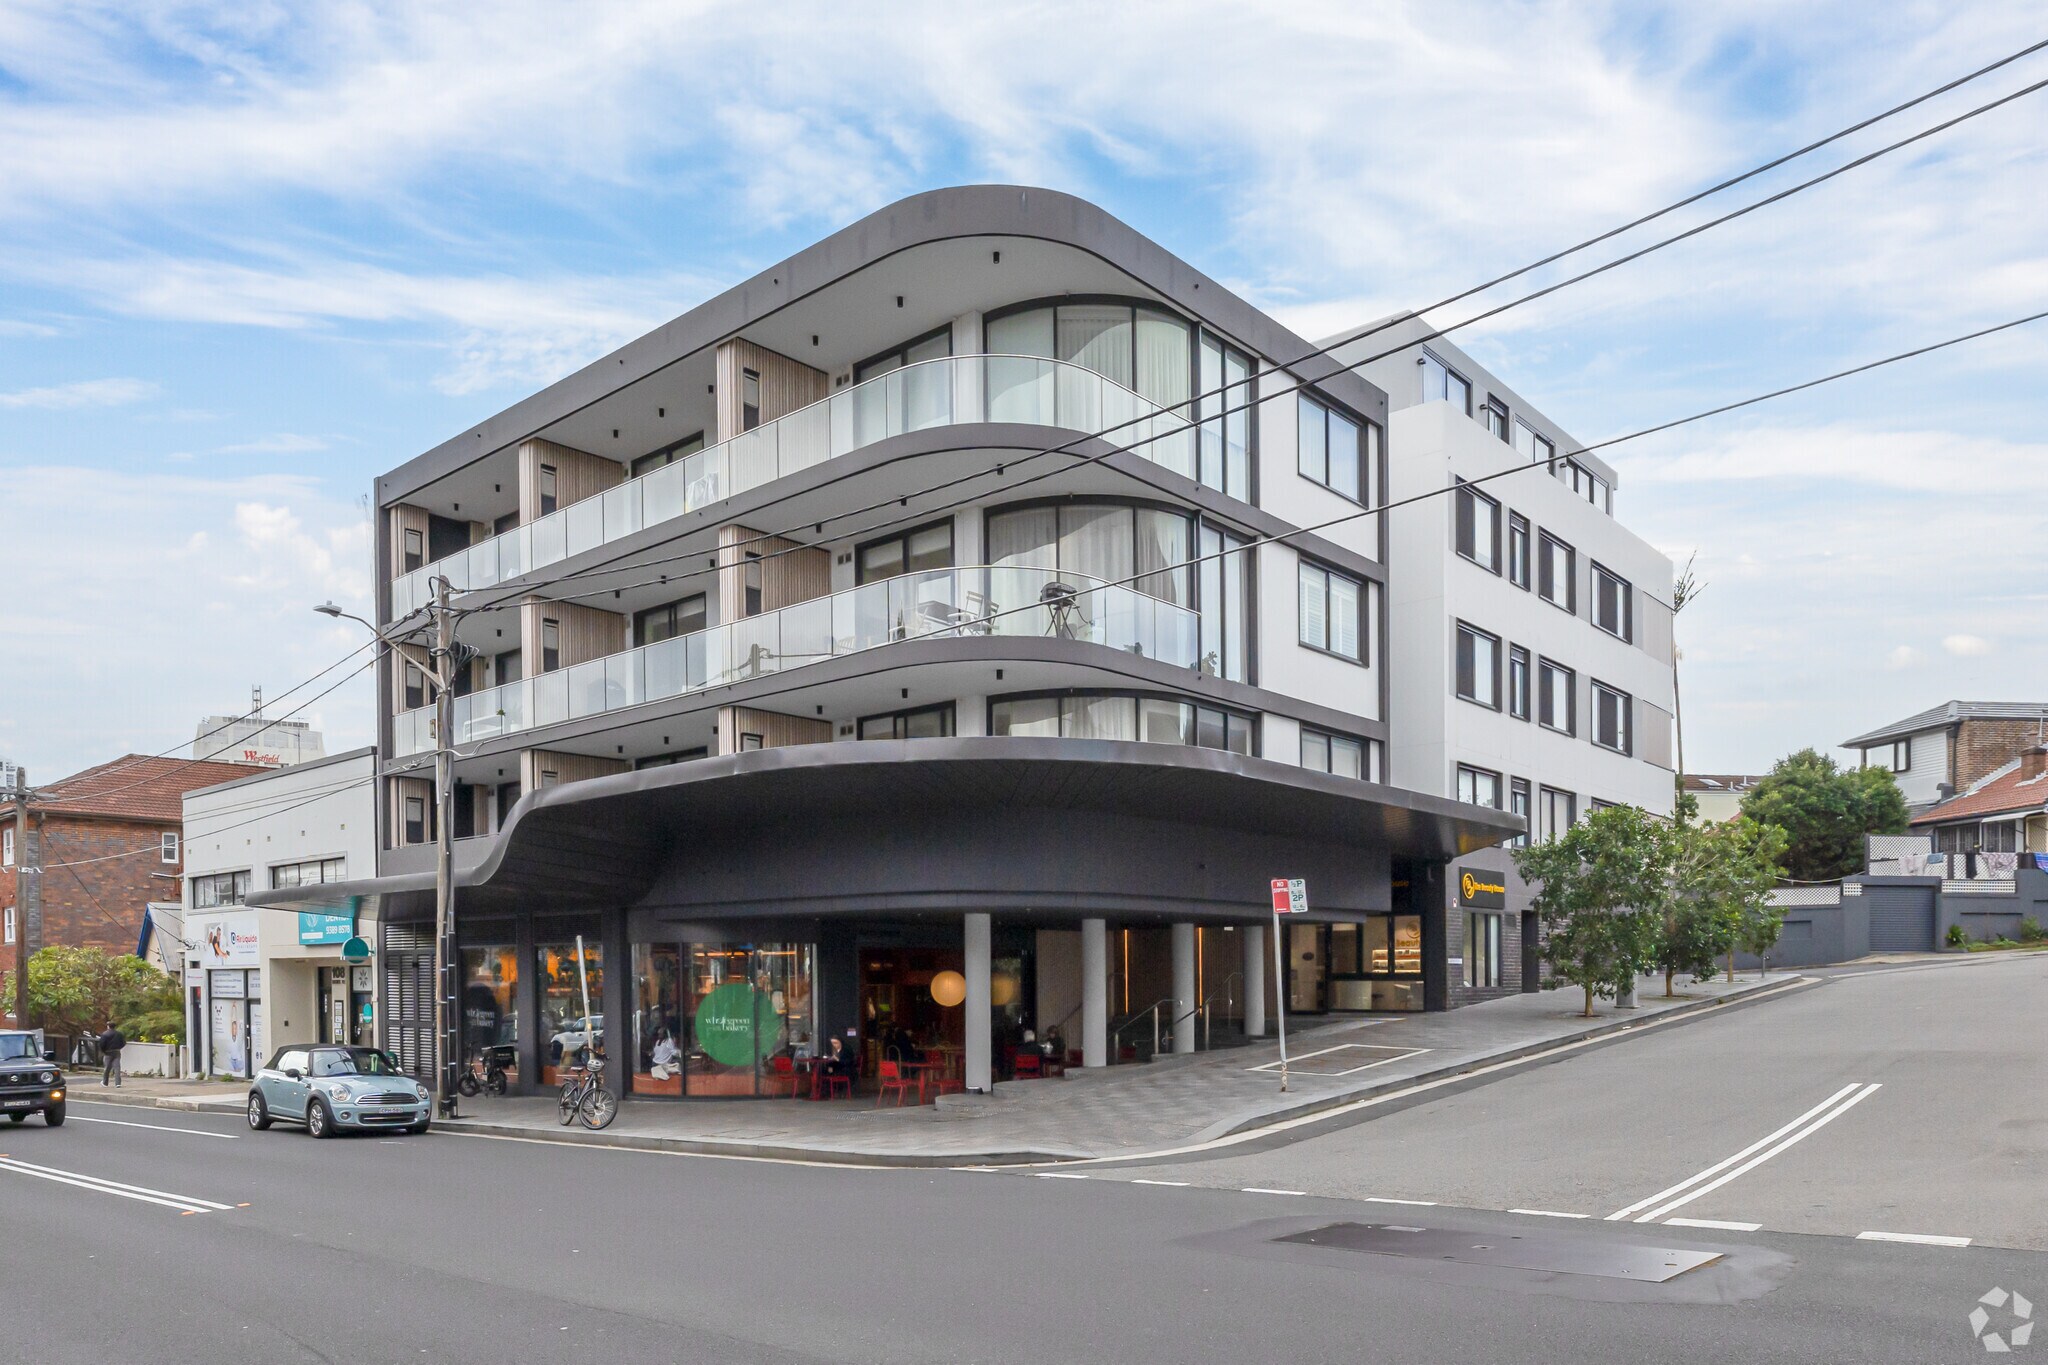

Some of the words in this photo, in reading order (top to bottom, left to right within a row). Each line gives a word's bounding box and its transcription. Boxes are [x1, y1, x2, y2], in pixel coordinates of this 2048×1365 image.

[243, 750, 280, 763] Westfield
[1292, 894, 1304, 902] 2P
[332, 966, 345, 978] 108
